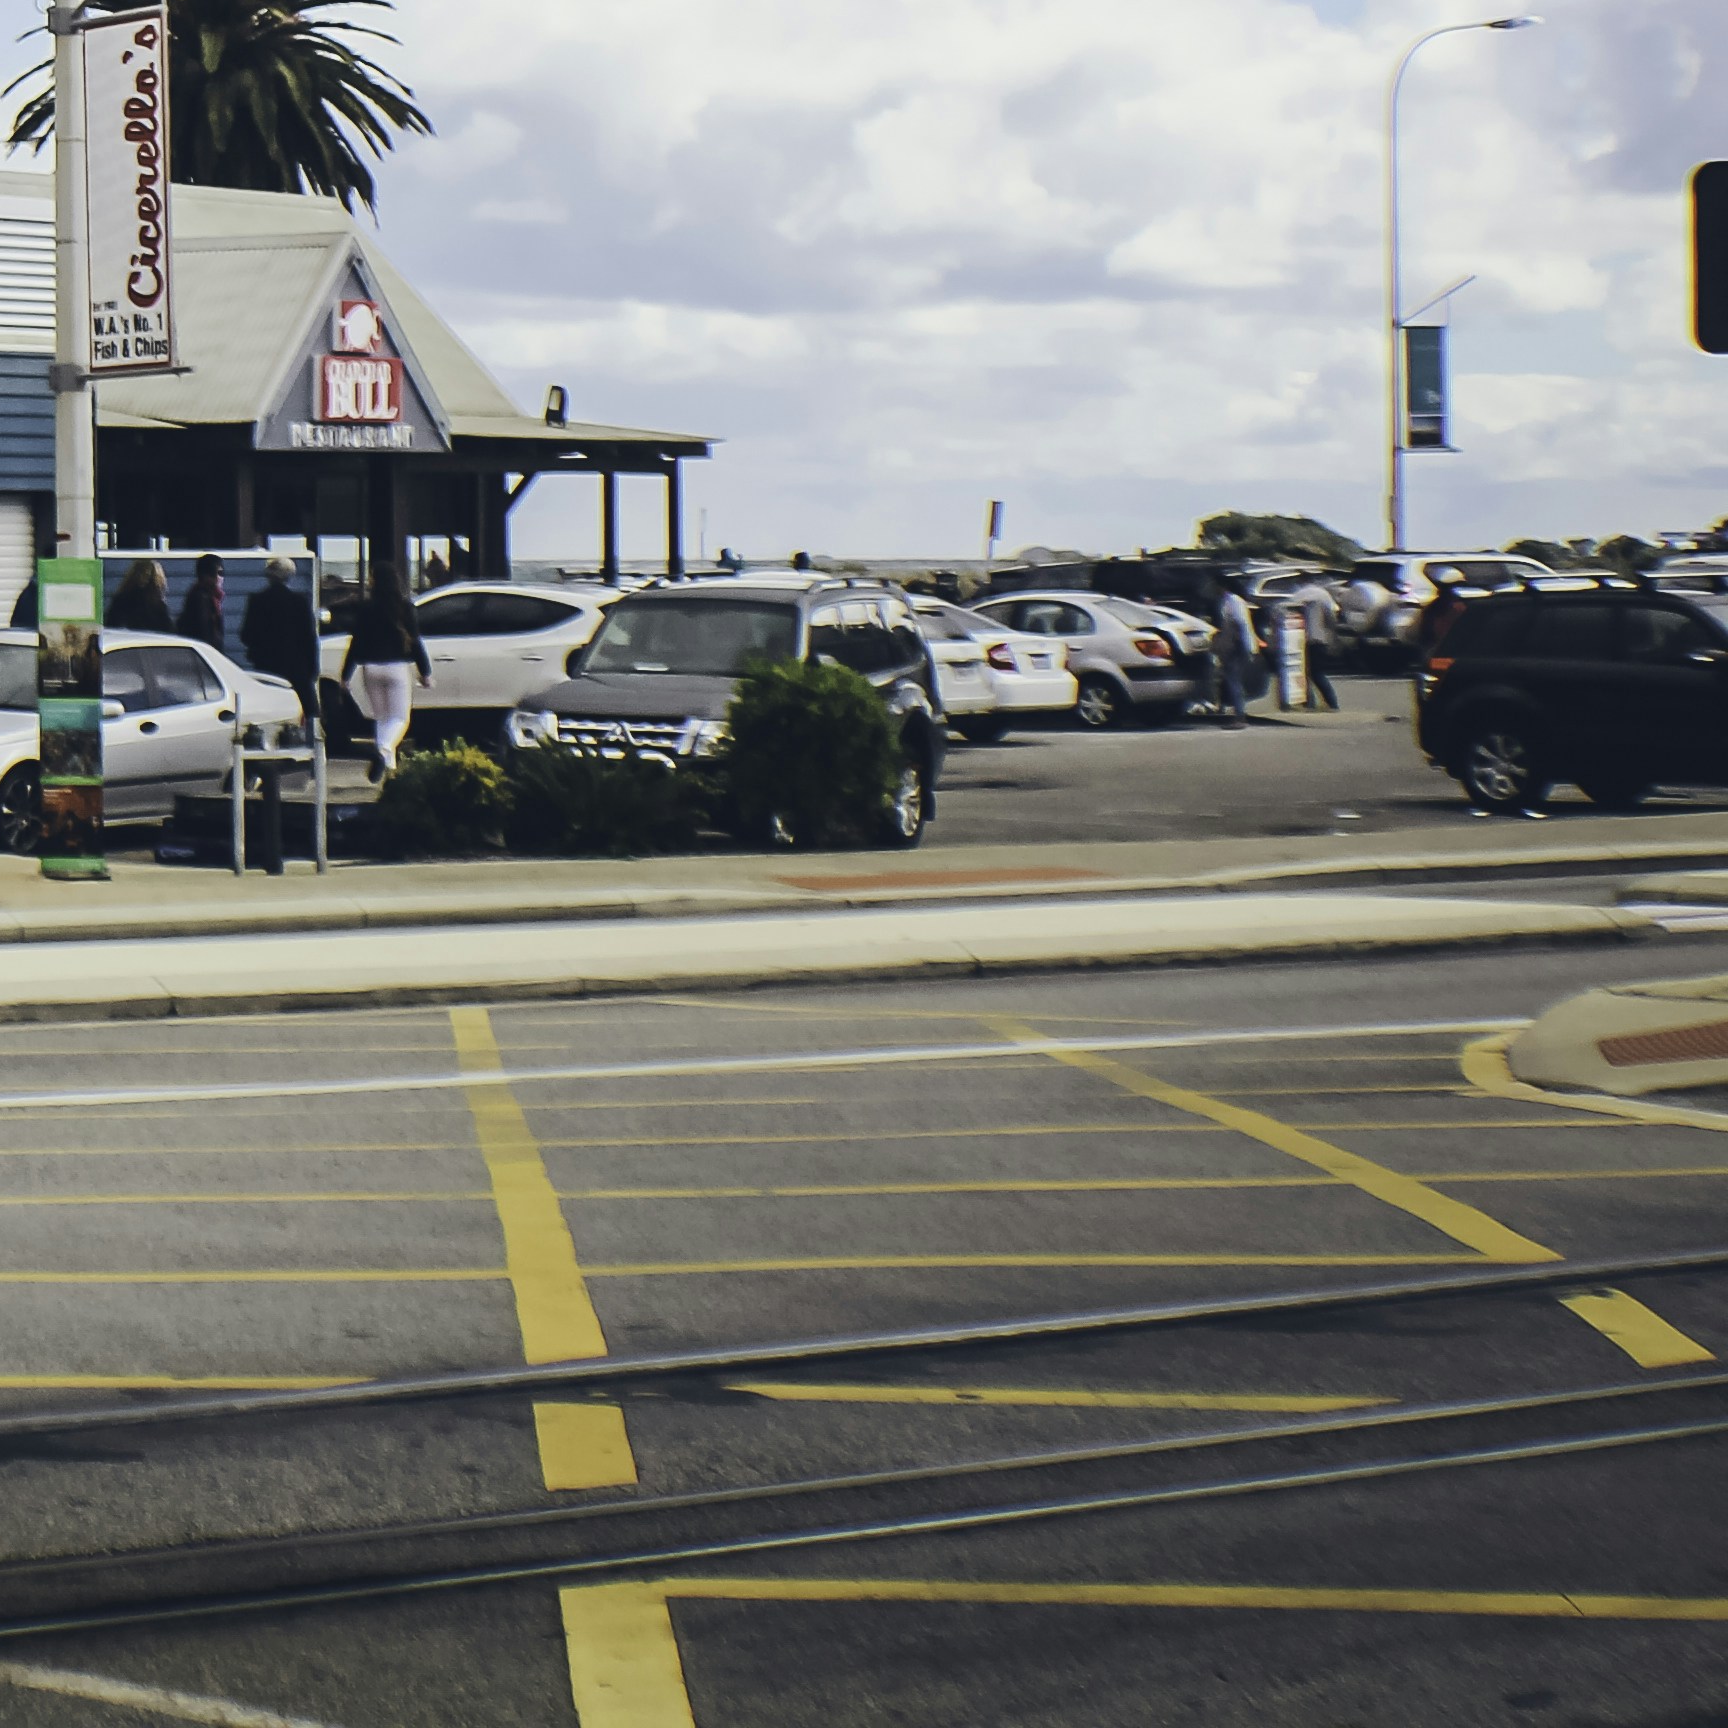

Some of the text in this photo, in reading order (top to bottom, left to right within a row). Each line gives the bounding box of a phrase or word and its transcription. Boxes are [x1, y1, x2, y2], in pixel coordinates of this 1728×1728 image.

[122, 24, 164, 308] Cicerello's
[134, 313, 153, 332] No.
[157, 313, 163, 331] 1
[94, 336, 169, 360] Fish & Chips
[291, 423, 414, 448] RESTAURANT
